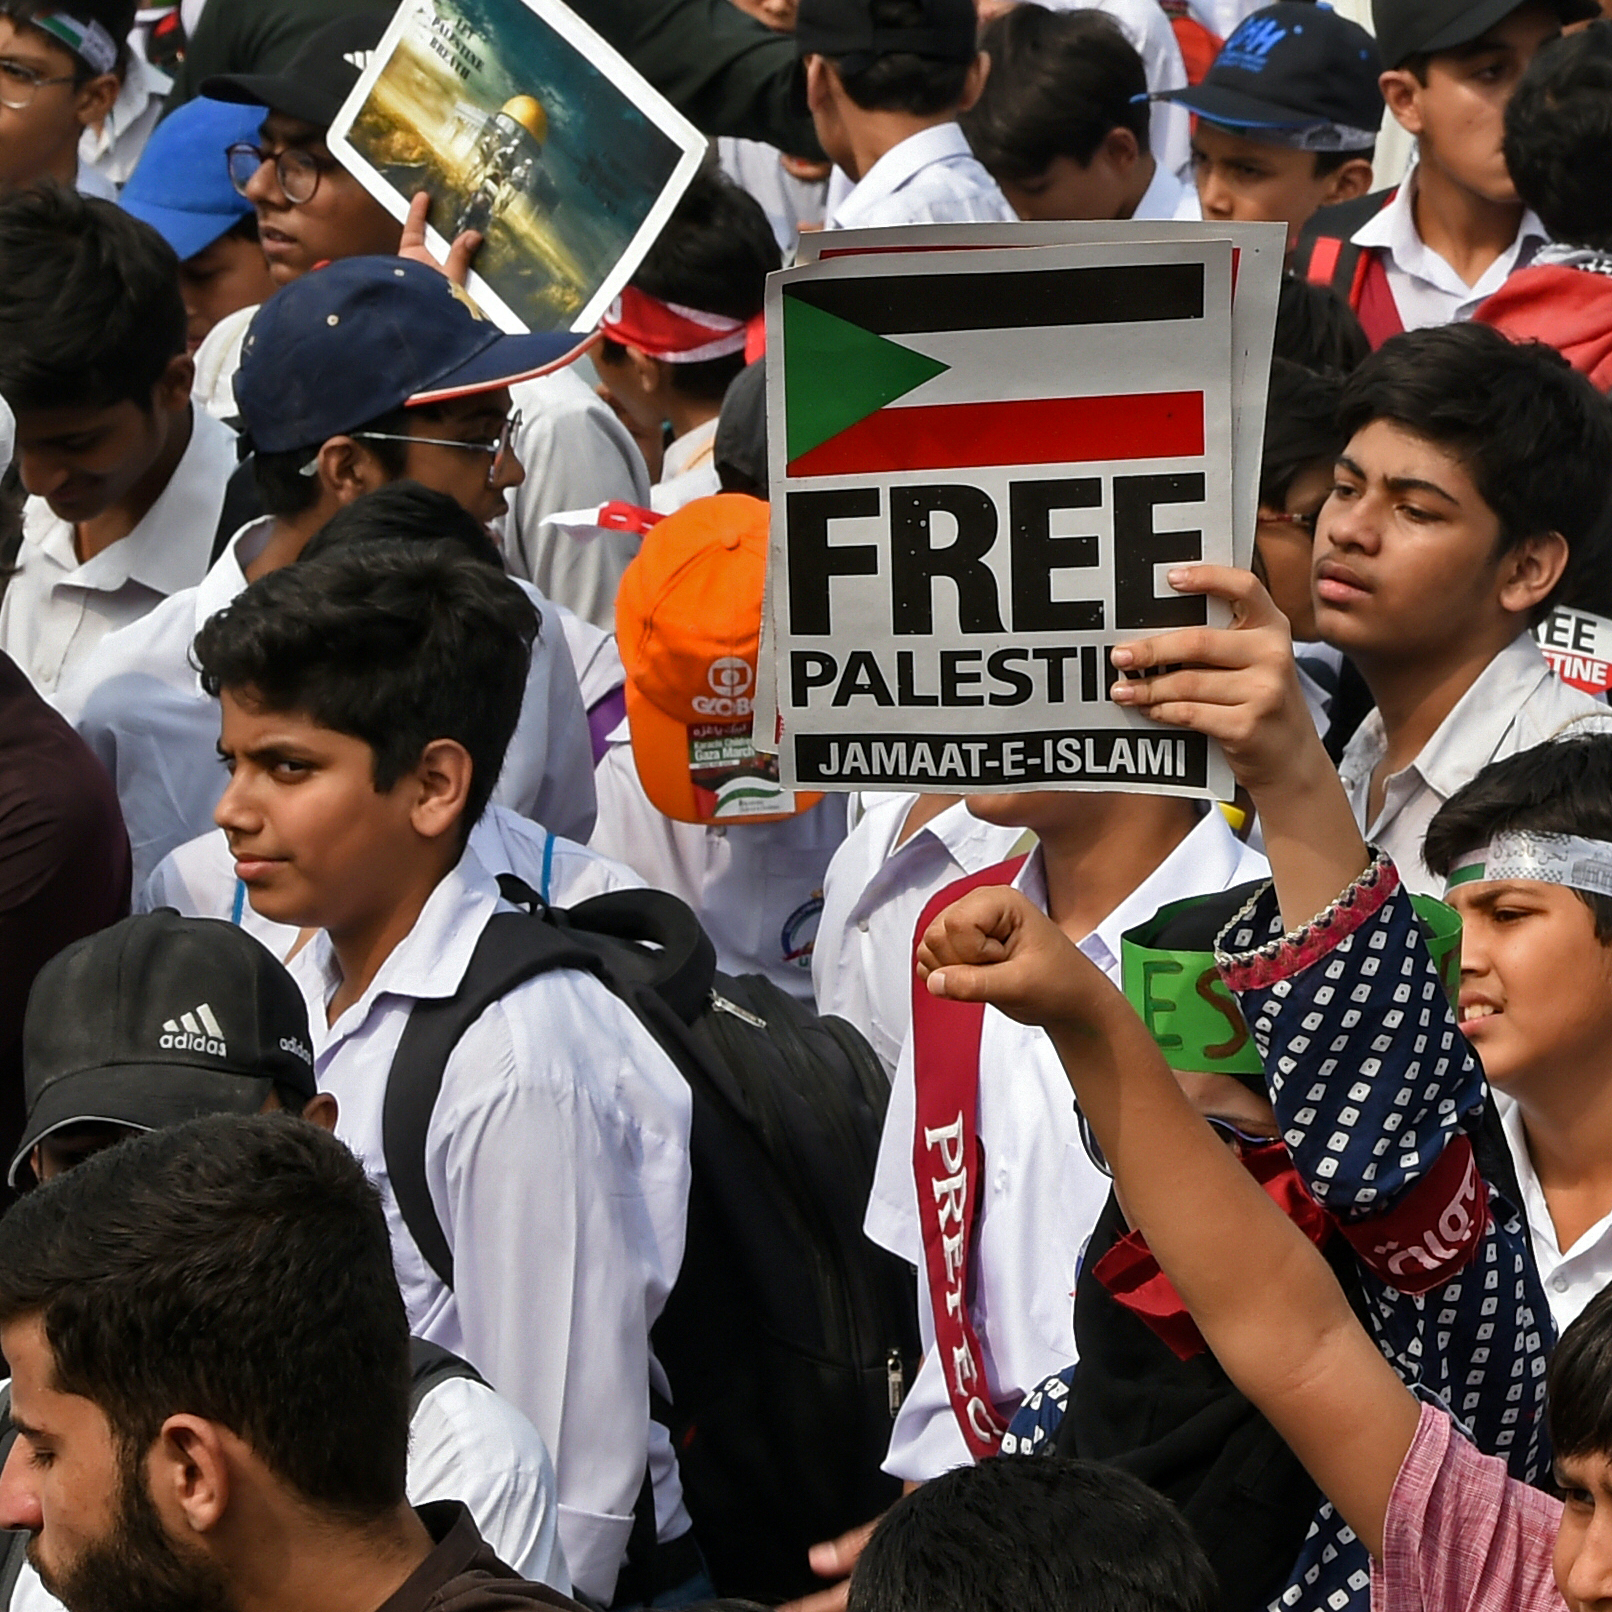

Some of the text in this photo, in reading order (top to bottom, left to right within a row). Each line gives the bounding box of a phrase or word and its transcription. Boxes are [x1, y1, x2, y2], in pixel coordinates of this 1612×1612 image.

[429, 35, 471, 81] BREATH
[431, 16, 485, 73] PALESTINE
[787, 471, 1209, 637] FREE
[1530, 611, 1598, 656] EE
[691, 694, 754, 717] GLOB
[694, 747, 756, 762] Gaza March
[817, 737, 1187, 778] JAMAAT-E-ISLAMI
[1143, 959, 1250, 1060] ES
[159, 1033, 228, 1059] adidas
[924, 1110, 1001, 1447] PREFEC
